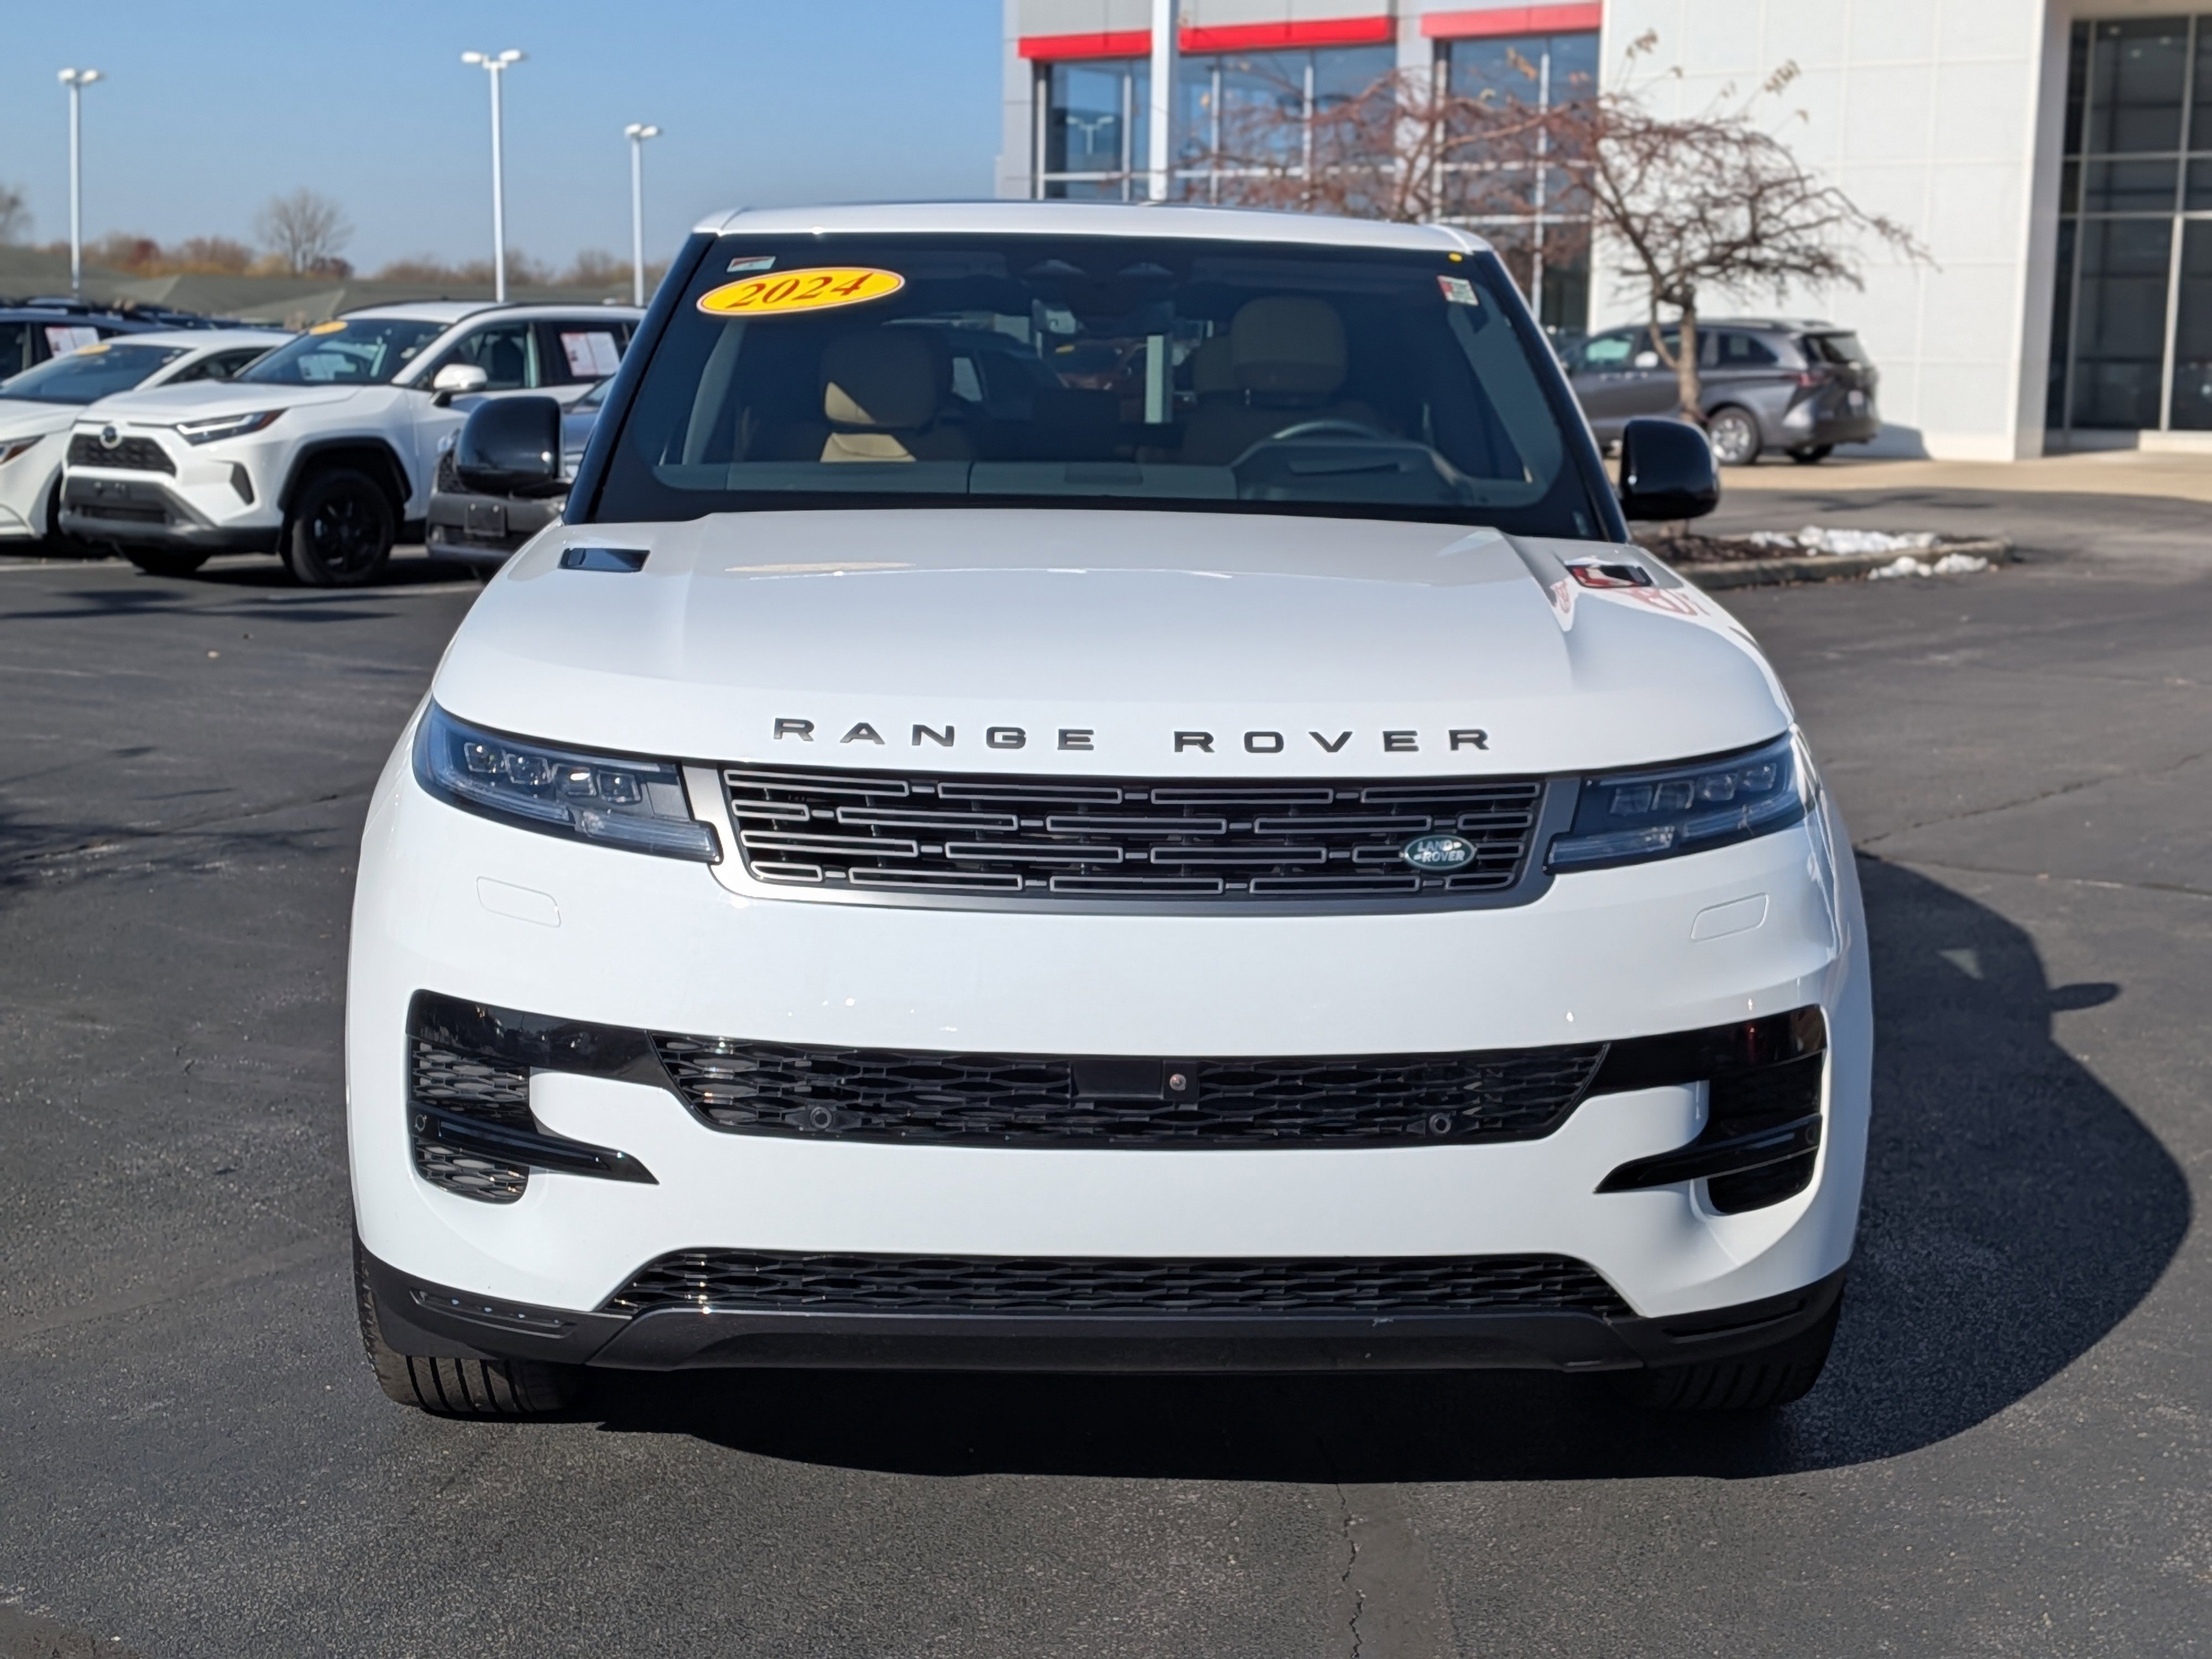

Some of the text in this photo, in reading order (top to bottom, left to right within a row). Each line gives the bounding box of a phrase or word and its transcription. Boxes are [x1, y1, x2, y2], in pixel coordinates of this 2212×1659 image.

[725, 272, 875, 309] 2024
[773, 717, 1490, 753] RANGE ROVER
[1417, 839, 1453, 852] LAND
[1422, 849, 1465, 863] ROVER
